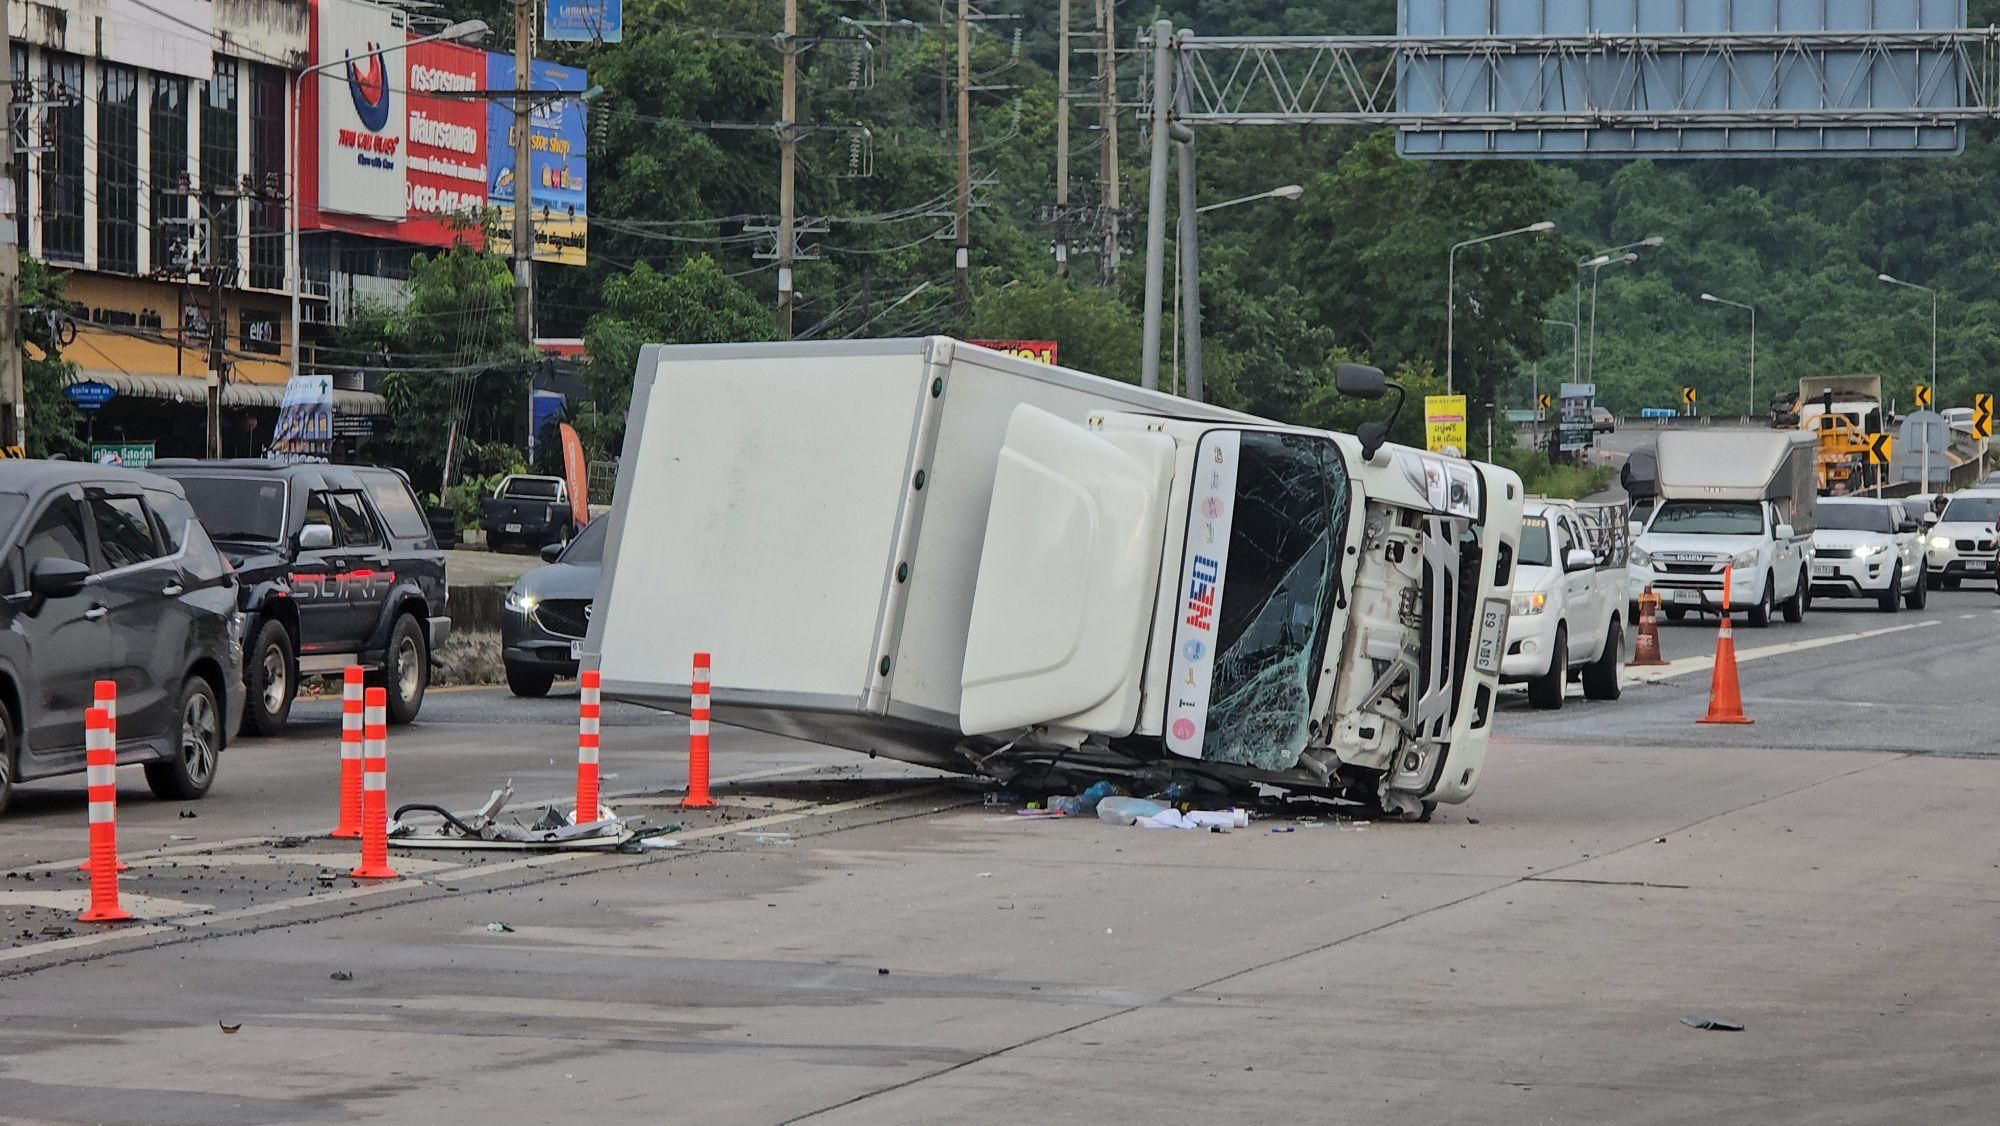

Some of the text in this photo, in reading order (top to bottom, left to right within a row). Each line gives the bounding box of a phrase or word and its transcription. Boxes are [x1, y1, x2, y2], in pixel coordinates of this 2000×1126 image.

[249, 320, 264, 341] elf
[1186, 554, 1219, 632] NEO
[1484, 610, 1497, 630] 63
